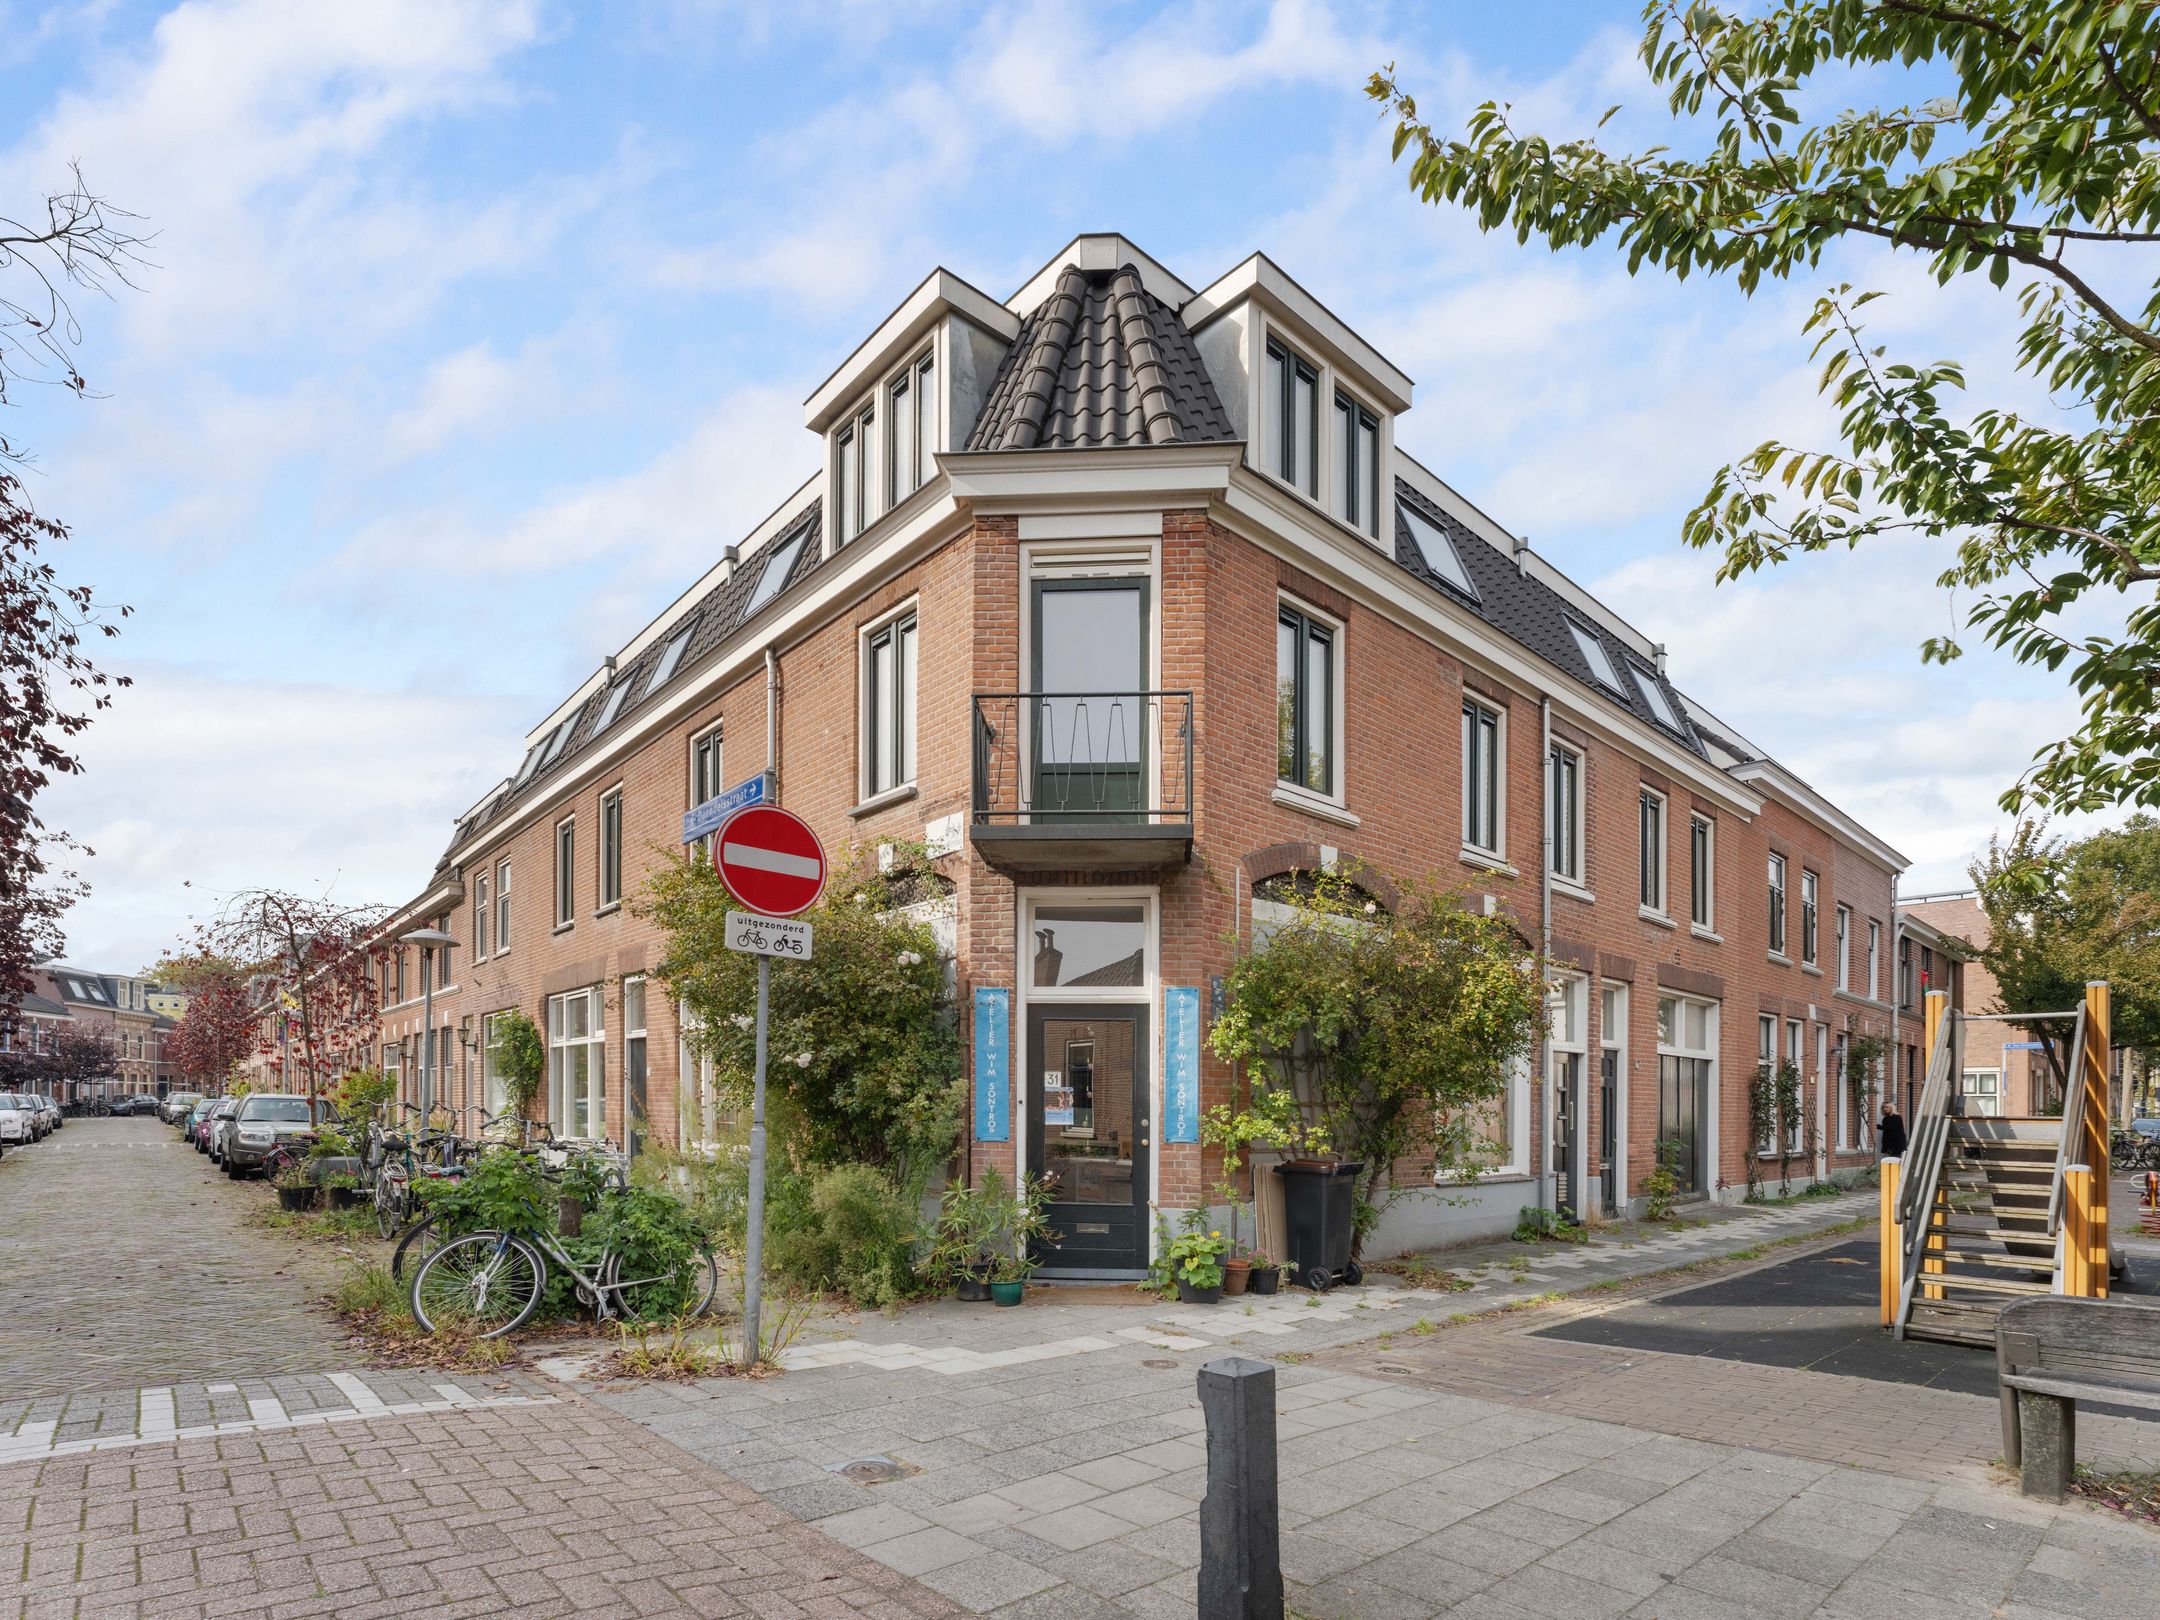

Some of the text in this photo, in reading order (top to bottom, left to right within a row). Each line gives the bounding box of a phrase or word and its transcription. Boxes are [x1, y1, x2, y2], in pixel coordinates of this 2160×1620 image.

[737, 917, 804, 934] uitgezonderd
[987, 1053, 996, 1076] WIM
[1177, 993, 1186, 1137] ATELIER WIM SONTROP
[1047, 1074, 1058, 1085] 31
